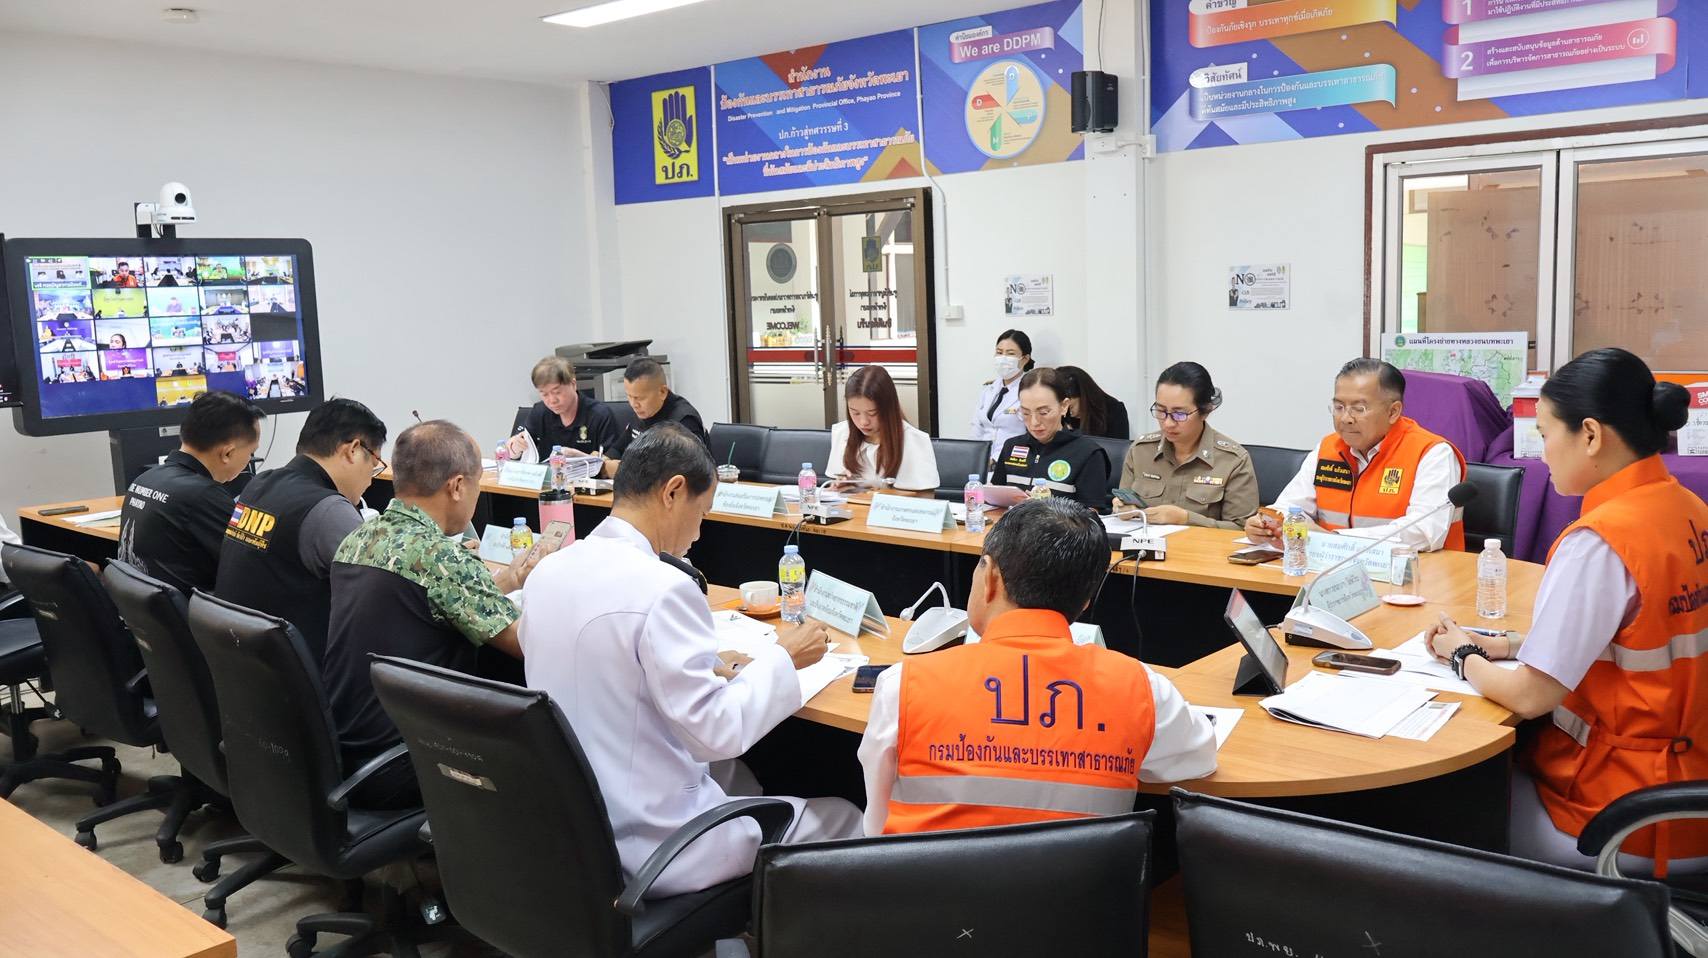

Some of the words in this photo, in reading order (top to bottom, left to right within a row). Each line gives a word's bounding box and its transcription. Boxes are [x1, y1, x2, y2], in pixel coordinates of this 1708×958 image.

[1463, 0, 1472, 15] 1
[959, 45, 978, 58] We
[981, 43, 1000, 54] are
[1003, 33, 1041, 51] DDPM
[1460, 51, 1474, 71] 2
[787, 66, 831, 83] สำนักงาน
[1204, 68, 1243, 84] วิสัยทัศน์
[728, 113, 746, 122] Disaster
[747, 110, 773, 119] Prevention
[776, 107, 785, 115] and
[786, 104, 811, 114] Mitigation
[813, 100, 837, 110] Provincial
[838, 97, 855, 107] Office,
[856, 94, 876, 105] Phayao
[877, 91, 901, 101] Province
[778, 121, 843, 141] ปภ.ก้าวสู่ทศวรรษที่
[843, 122, 849, 131] 3
[661, 161, 693, 180] ปภ.
[135, 485, 153, 498] NUMBER
[152, 490, 169, 503] ONE
[237, 506, 275, 537] DNP
[984, 654, 1106, 732] ปภ.
[928, 733, 1136, 776] กรมป้องกันและบรรเทาสาธารณภัย
